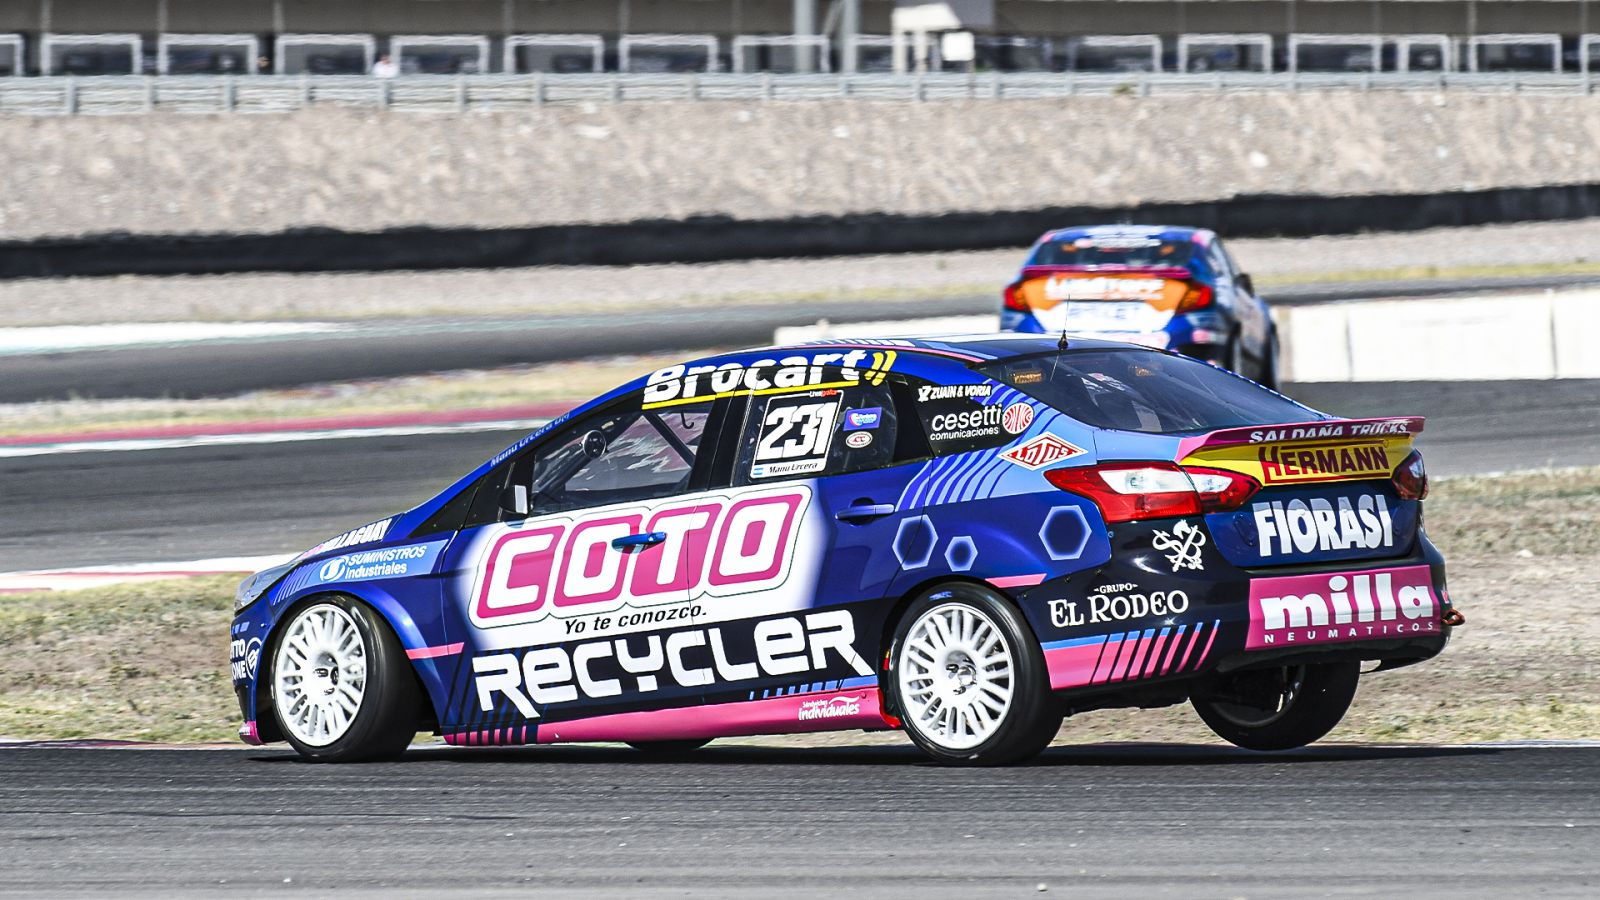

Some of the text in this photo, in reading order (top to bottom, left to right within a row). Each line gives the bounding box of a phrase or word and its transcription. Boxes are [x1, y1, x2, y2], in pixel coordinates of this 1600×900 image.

[643, 350, 867, 404] Brocart
[930, 385, 956, 399] ZUAIN
[957, 386, 963, 396] &
[756, 402, 838, 461] 231
[931, 404, 1002, 432] cesetti
[1249, 420, 1409, 443] SALDAÑA TRUCKS
[930, 426, 999, 440] comunicaciones
[1016, 439, 1069, 468] LOTUS
[1258, 446, 1390, 477] HERMANN
[769, 465, 791, 474] Manu
[1252, 494, 1393, 557] FIORASI
[348, 545, 427, 566] SUMINISTROS
[477, 493, 803, 619] COTO
[345, 562, 407, 579] Industriales
[1099, 582, 1133, 593] GRUPO
[1260, 573, 1433, 630] milla
[565, 605, 707, 634] Yo te conozco.
[1047, 589, 1189, 628] EL RODEO
[1264, 622, 1433, 644] NEUMATICOS
